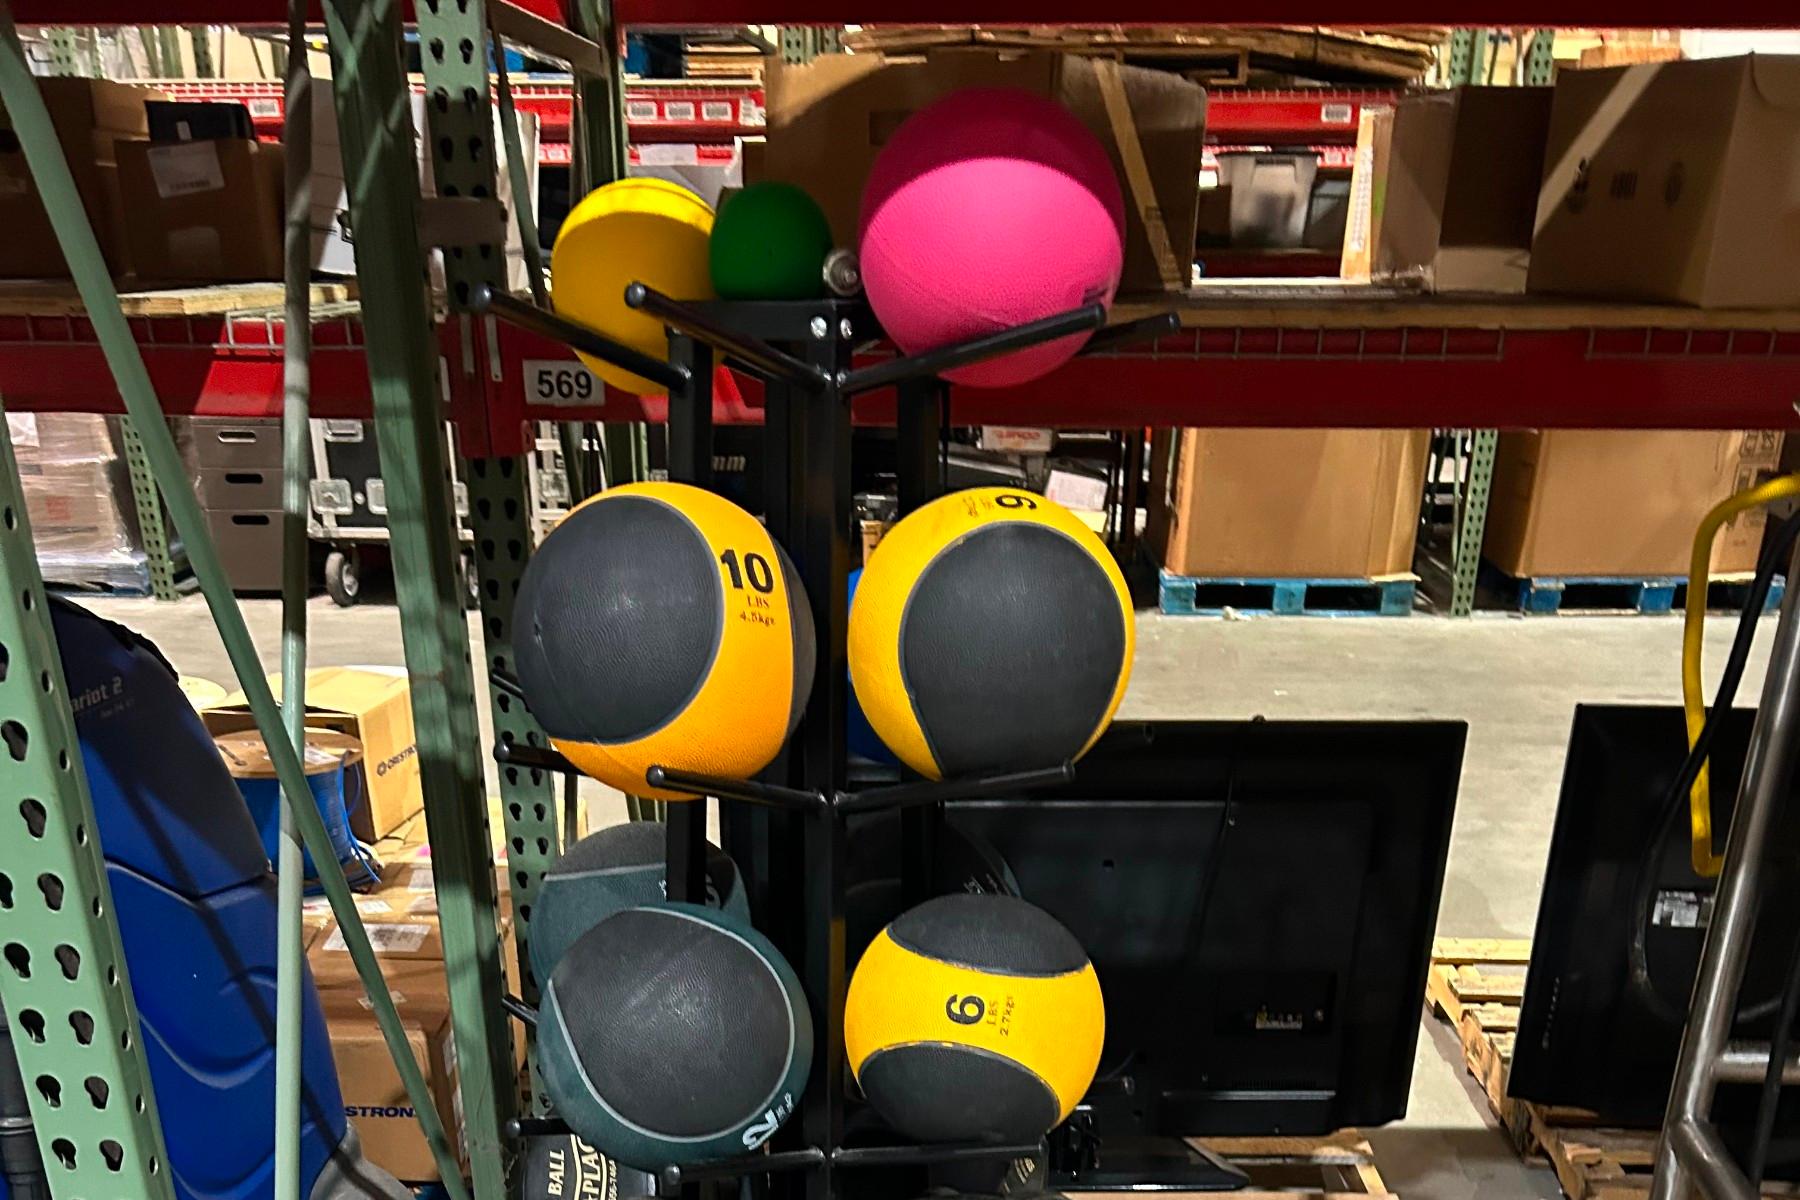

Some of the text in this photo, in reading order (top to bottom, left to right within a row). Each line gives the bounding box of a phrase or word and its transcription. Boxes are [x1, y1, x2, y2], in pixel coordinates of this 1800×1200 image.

[537, 369, 592, 399] 569
[720, 549, 774, 594] 10
[71, 684, 109, 712] ariot
[112, 676, 123, 695] 2
[946, 994, 985, 1025] 6
[344, 1106, 414, 1118] STRON
[548, 1149, 565, 1196] BALL
